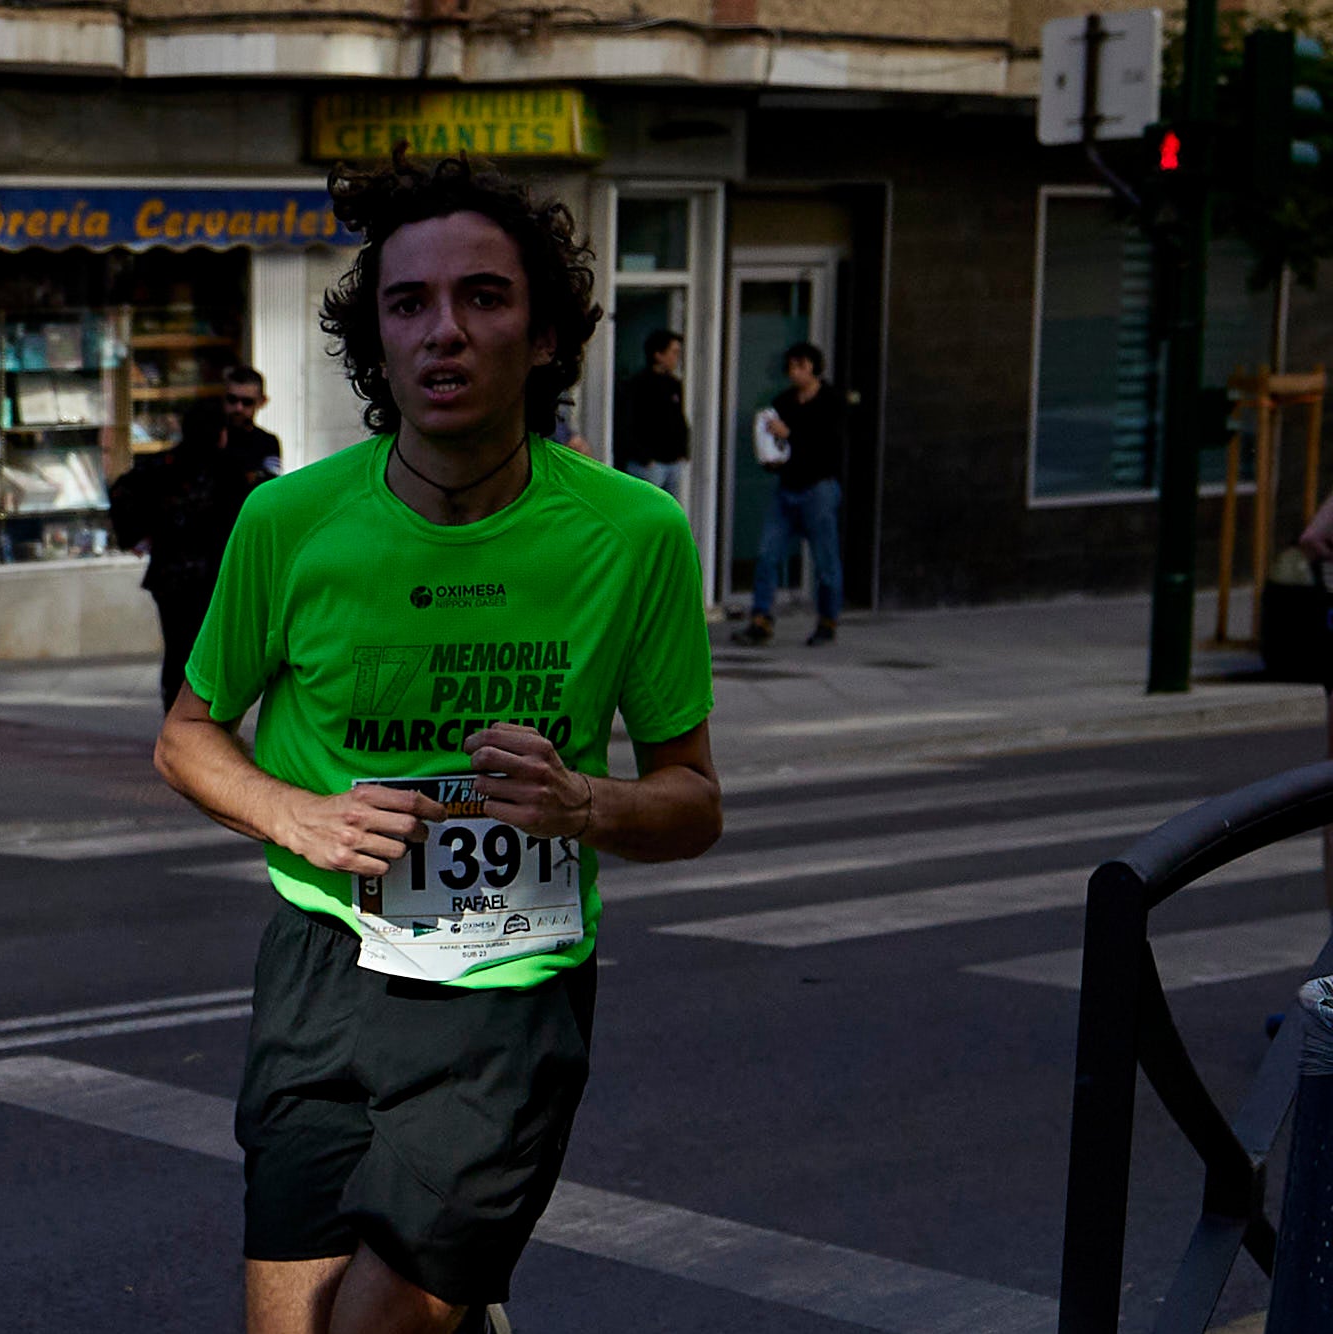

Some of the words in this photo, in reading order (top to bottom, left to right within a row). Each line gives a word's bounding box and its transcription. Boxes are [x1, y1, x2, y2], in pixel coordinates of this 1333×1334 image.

[336, 122, 554, 154] CERVANTES
[134, 199, 338, 239] Cervantes
[435, 598, 473, 608] NIPPON
[436, 584, 507, 597] OXIMESA
[351, 645, 432, 716] 17
[429, 641, 571, 673] MEMORIAL
[430, 674, 565, 713] PADRE
[405, 823, 552, 891] 1391
[452, 895, 508, 912] RAFAEL
